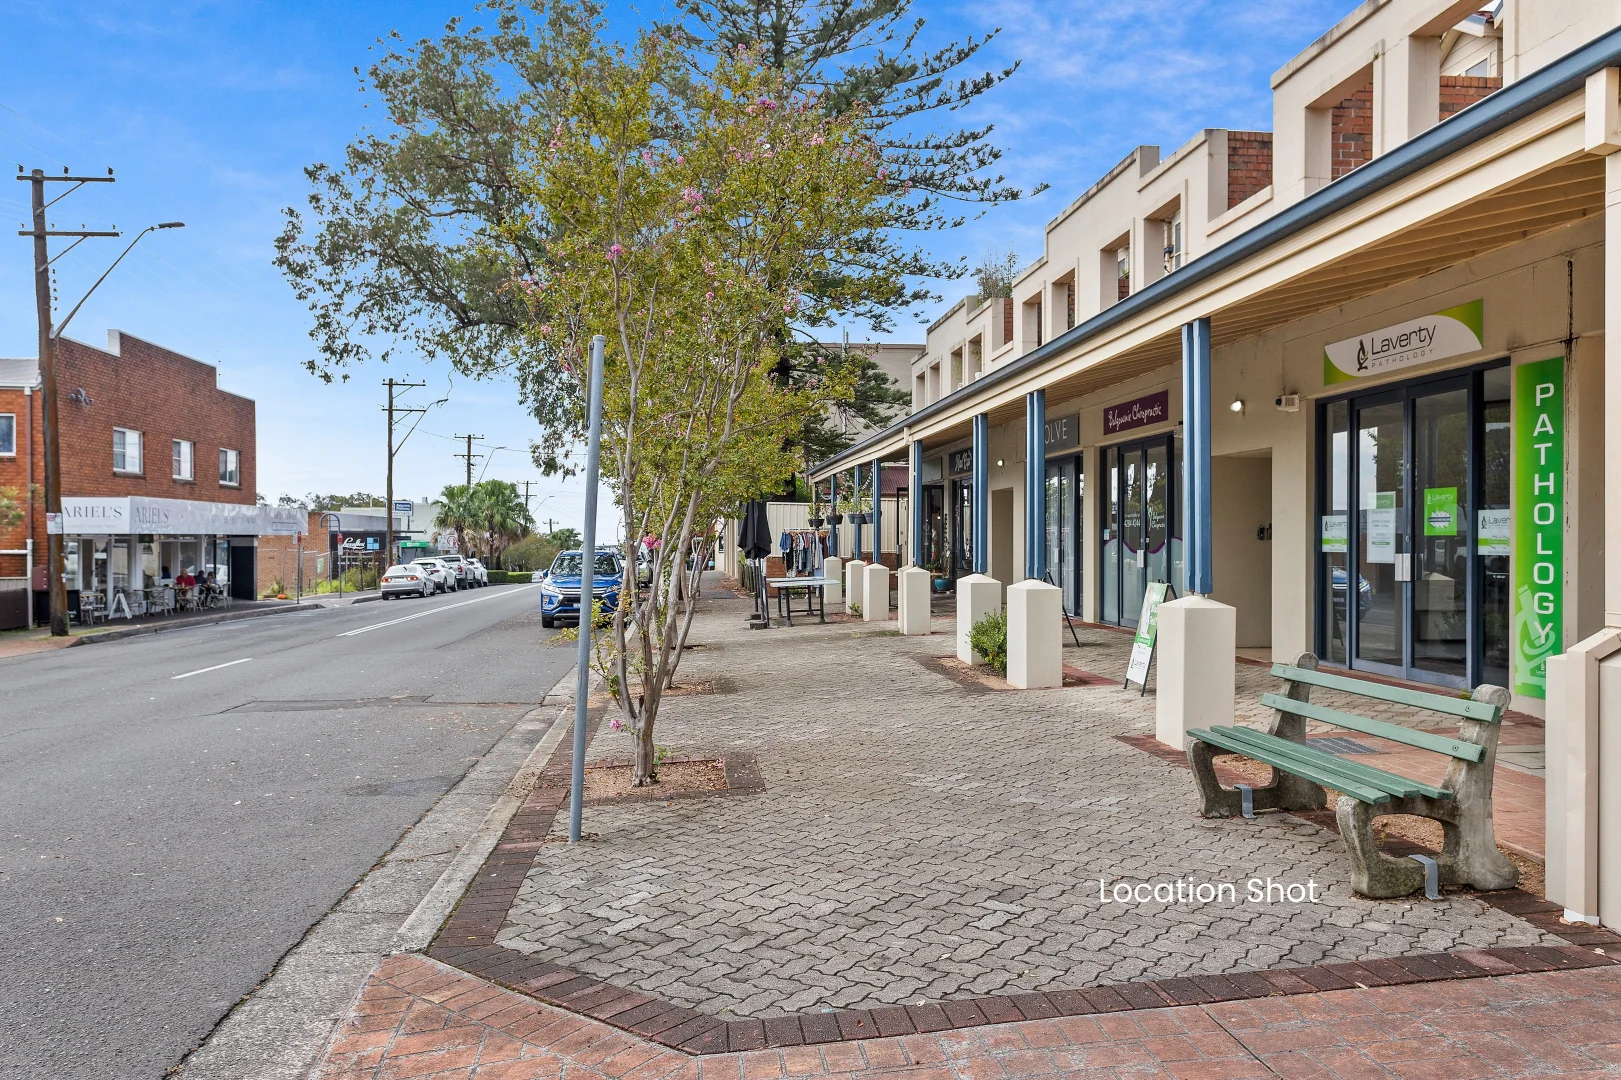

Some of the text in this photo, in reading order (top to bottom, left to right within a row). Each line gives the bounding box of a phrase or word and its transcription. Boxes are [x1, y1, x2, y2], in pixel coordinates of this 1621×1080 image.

[1371, 324, 1437, 356] Laverty
[1371, 347, 1434, 368] PATHOLOGY
[1131, 402, 1162, 423] Chiropractic
[1432, 493, 1454, 501] Laverty
[63, 506, 123, 519] ARIEL'S
[134, 506, 170, 525] ARIEL'S
[1488, 516, 1511, 525] Laver
[1532, 381, 1556, 645] PATHOLOGY
